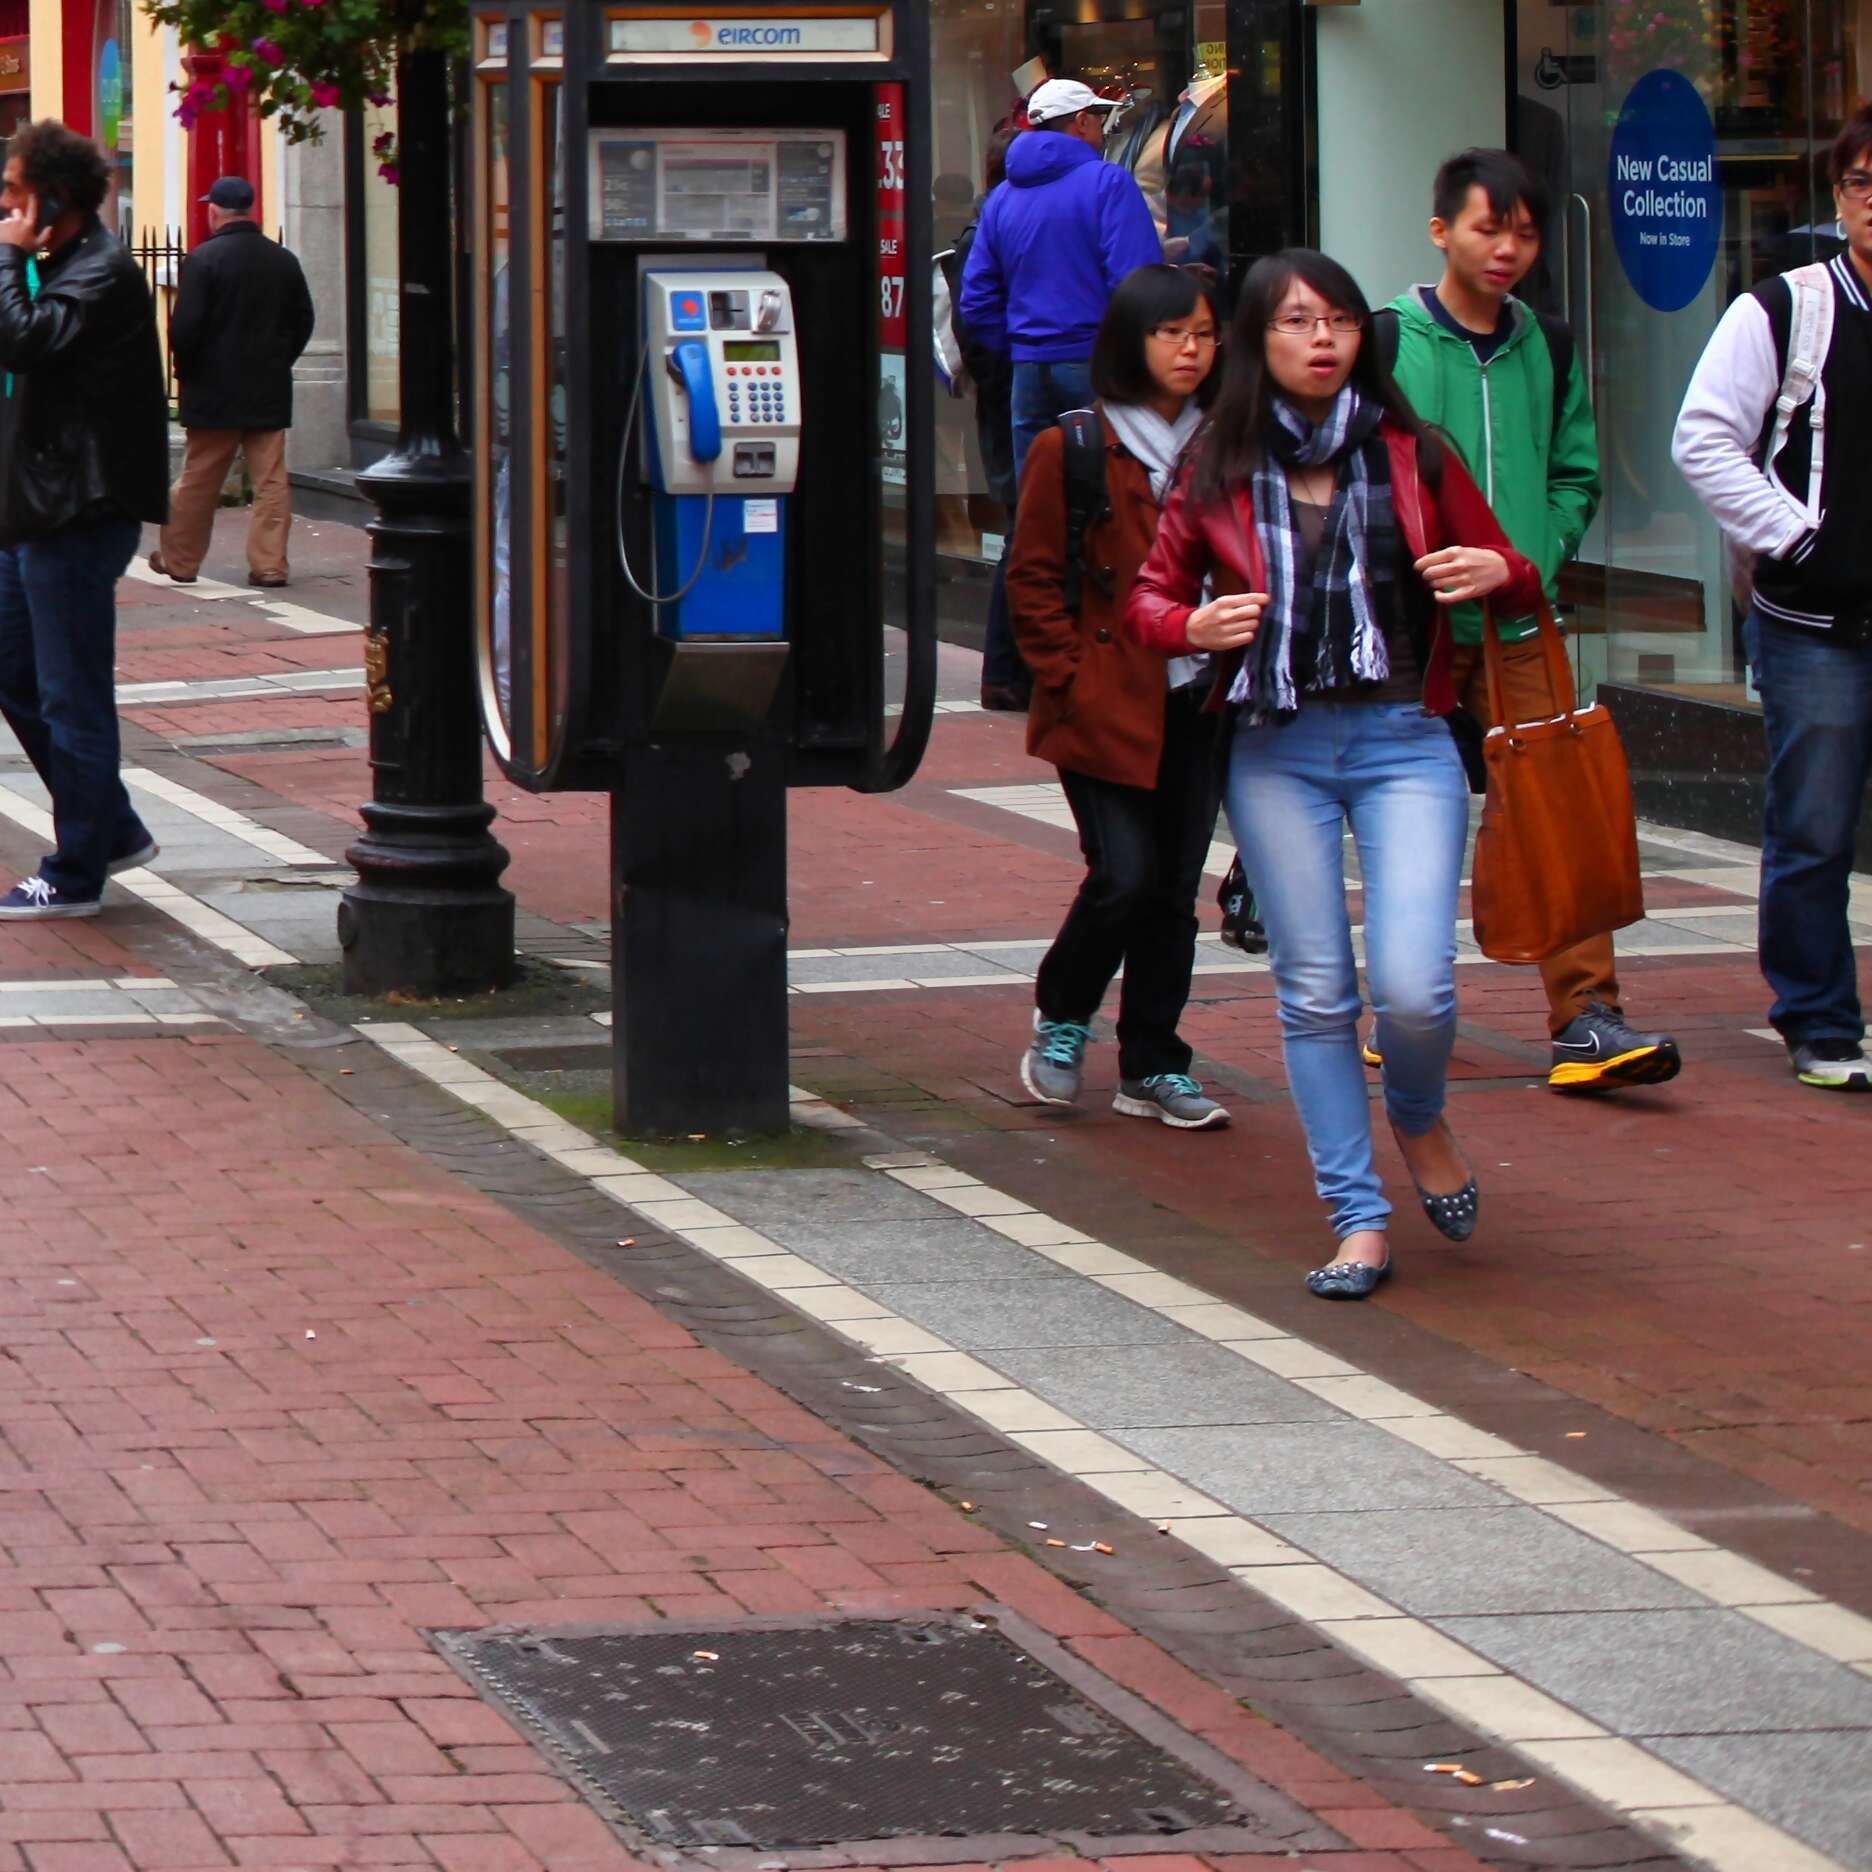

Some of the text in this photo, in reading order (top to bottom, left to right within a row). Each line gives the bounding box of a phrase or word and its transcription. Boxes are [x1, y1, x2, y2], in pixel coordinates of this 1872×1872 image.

[1617, 154, 1712, 182] New Casual
[1623, 189, 1707, 218] Collection
[1639, 232, 1691, 247] Now in Store
